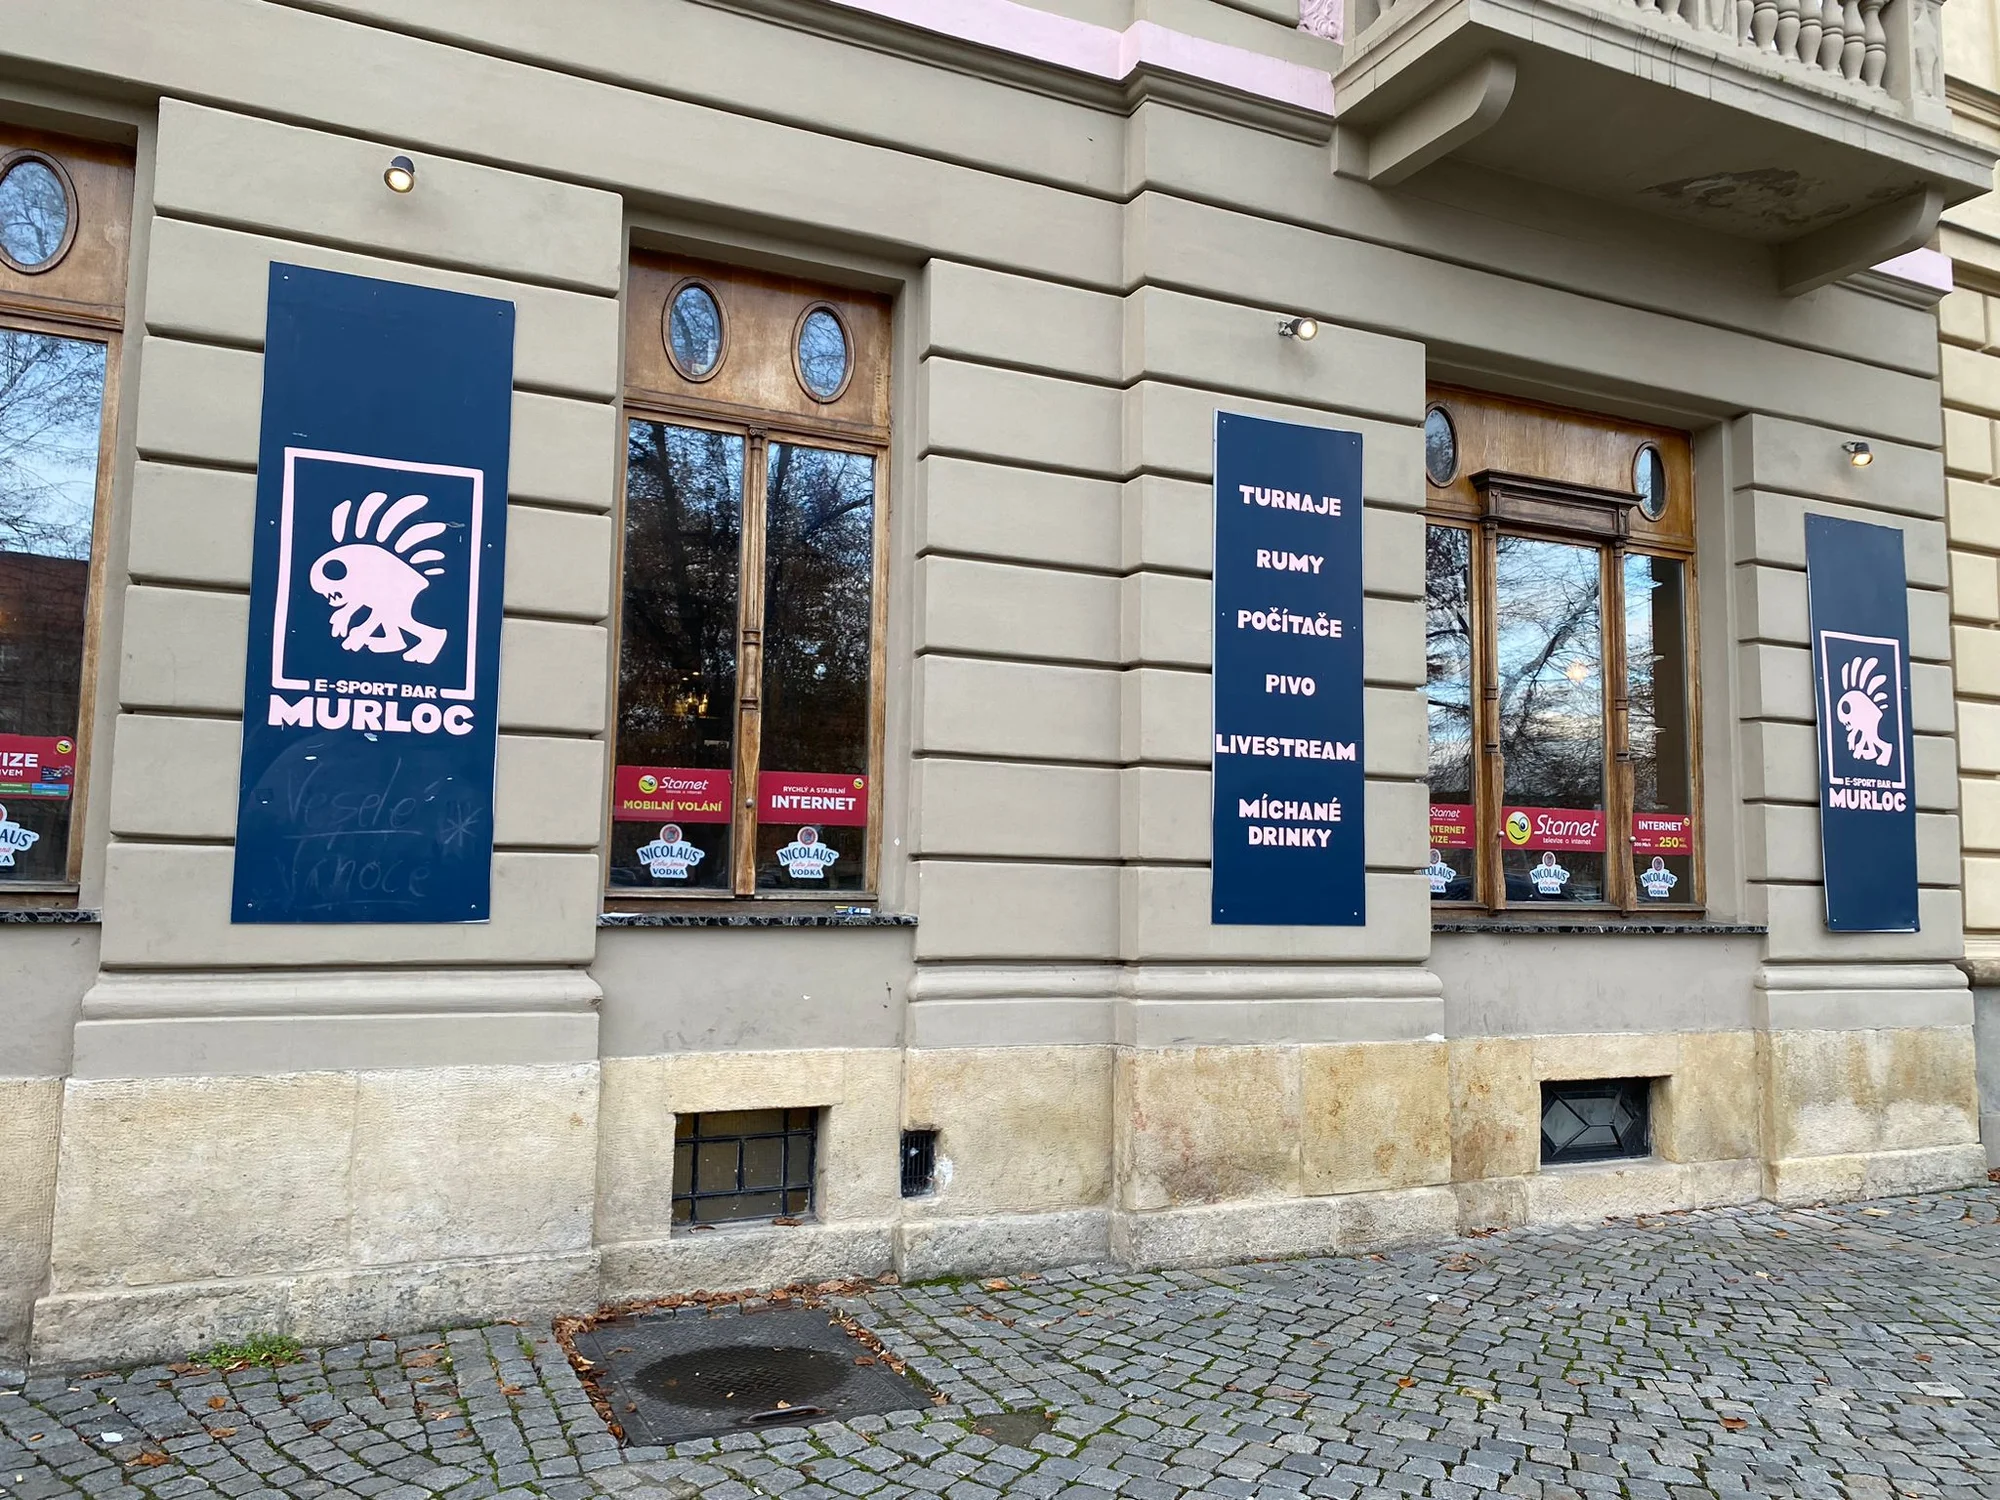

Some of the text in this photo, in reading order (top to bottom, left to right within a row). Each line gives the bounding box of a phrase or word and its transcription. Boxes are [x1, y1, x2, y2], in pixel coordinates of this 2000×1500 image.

[1238, 484, 1342, 517] TURNAJE
[1256, 549, 1325, 575] RUMY
[1237, 607, 1343, 638] POČÍTAČE
[314, 678, 438, 700] E-SPORT BAR
[1265, 673, 1316, 696] PIVO
[267, 694, 475, 736] MURLOC
[1215, 733, 1356, 761] LIVESTREAM
[782, 785, 808, 793] RYCHLÝ
[1844, 777, 1892, 789] E-SPORT BAR
[623, 799, 723, 812] MOBILNÍ VOLÁNÍ
[771, 795, 857, 811] INTERNET
[1238, 793, 1342, 822] MÍCHANÉ
[1829, 787, 1907, 812] MURLOC
[1533, 814, 1600, 837] Starnet
[1638, 821, 1682, 831] INTERNET
[1248, 826, 1332, 848] DRINKY
[1659, 836, 1680, 848] 250
[640, 845, 700, 863] NICOLAUS
[780, 847, 835, 863] NICOLAUS
[652, 868, 685, 876] VODKA
[1531, 868, 1568, 882] NICOLAUS
[1642, 872, 1676, 886] NICOLAUS
